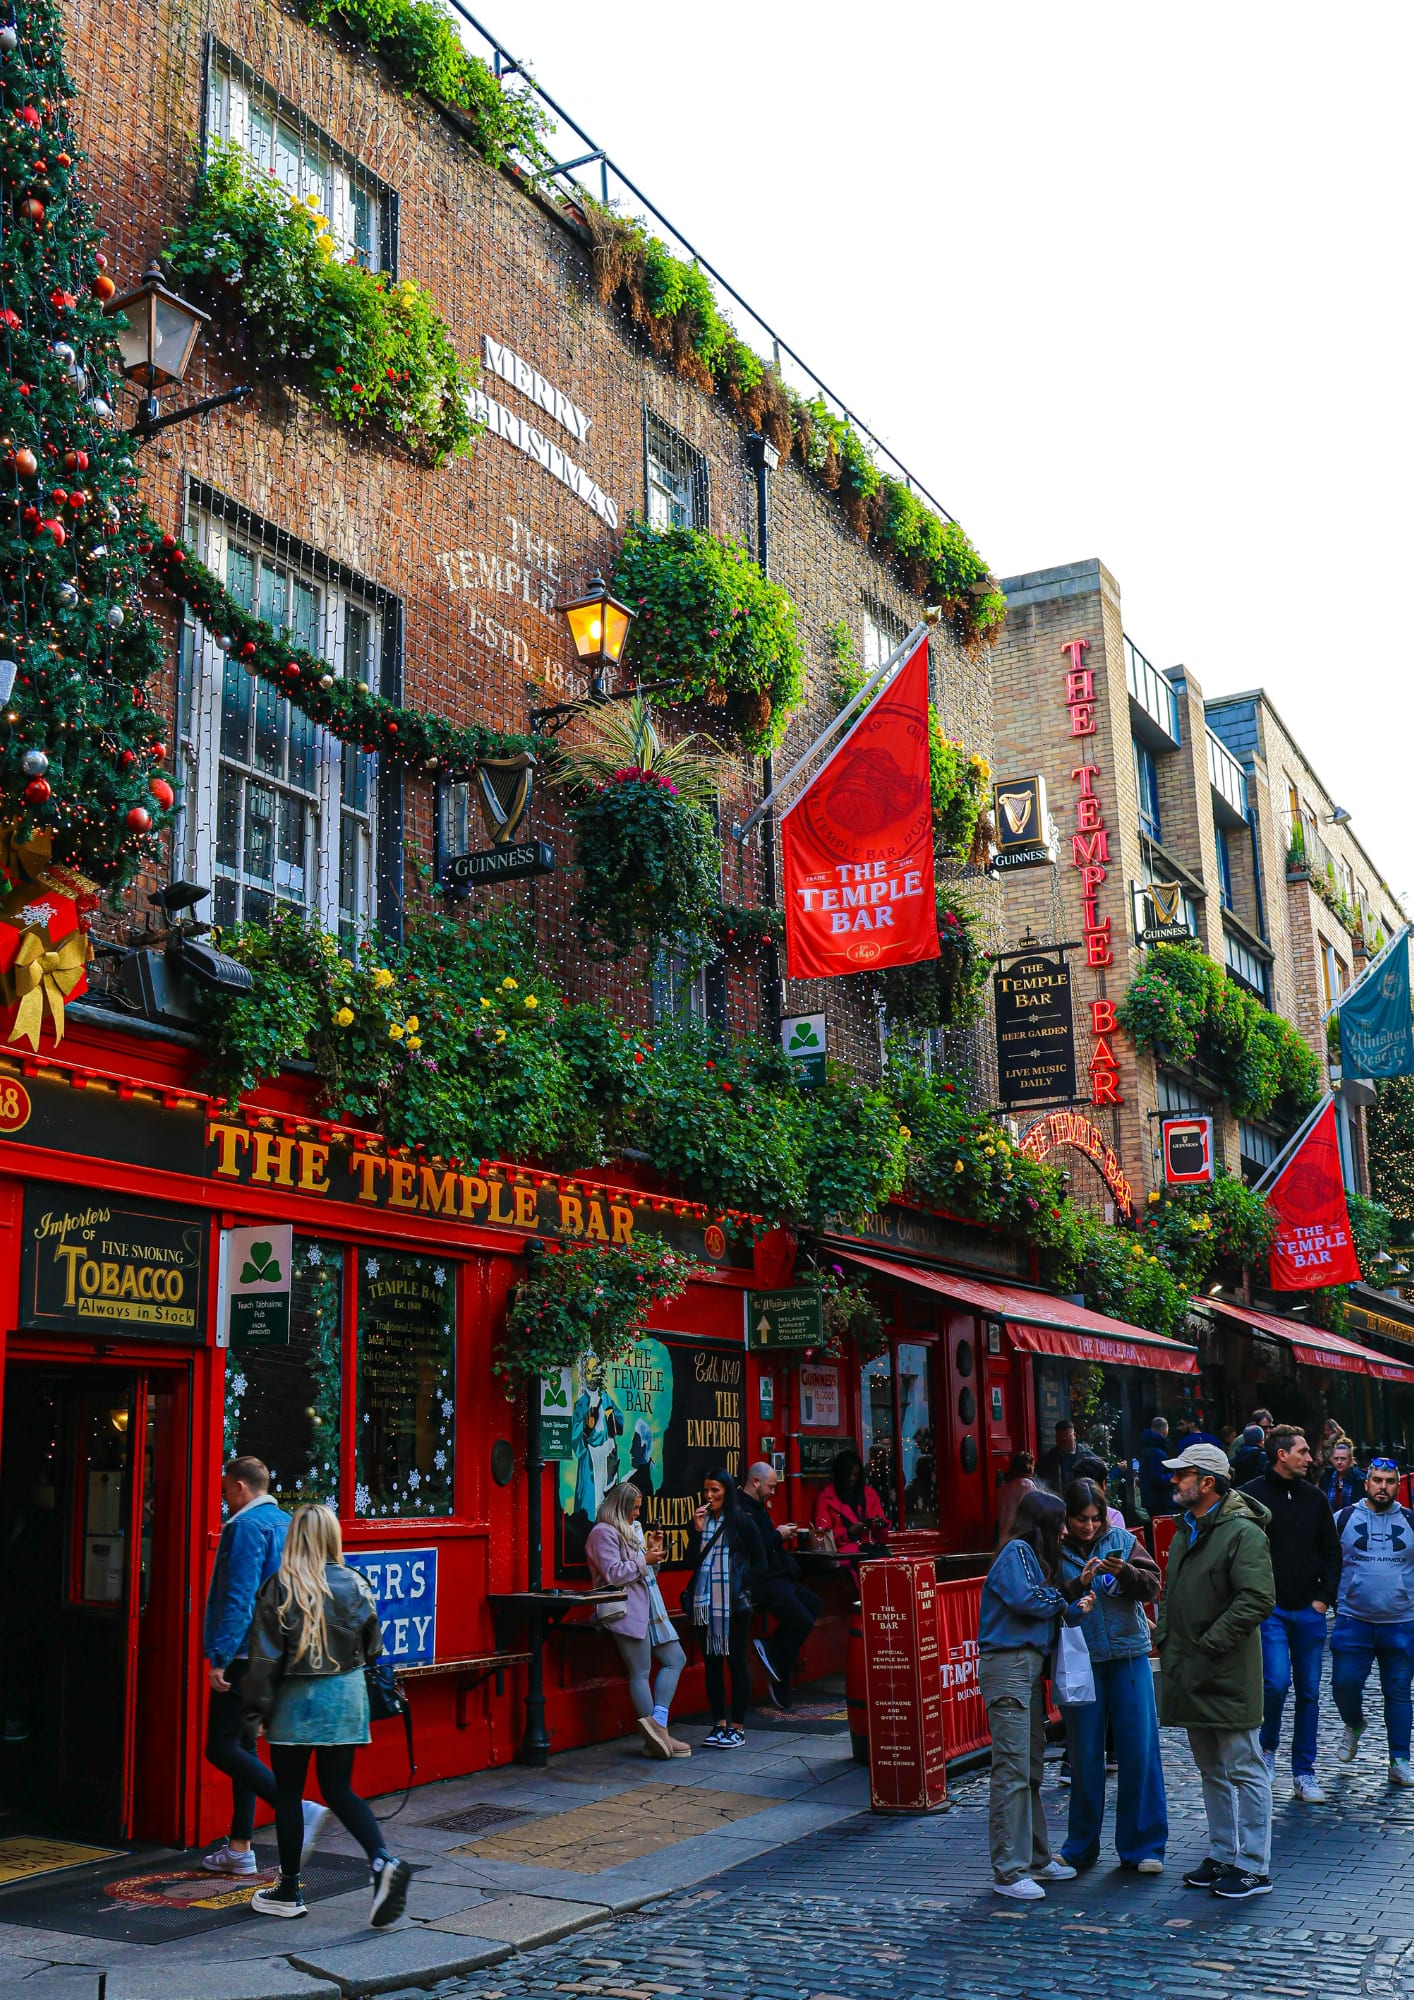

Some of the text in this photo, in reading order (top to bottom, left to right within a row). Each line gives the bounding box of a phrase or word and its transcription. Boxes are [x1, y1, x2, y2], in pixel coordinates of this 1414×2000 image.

[482, 334, 593, 445] MERRY
[505, 515, 561, 582] THE
[435, 549, 558, 620] TEMPLE
[455, 847, 535, 877] GUINNESS
[995, 848, 1048, 867] GUINNESS
[836, 861, 888, 883] THE
[1061, 639, 1123, 1106] THE TEMPLE BAR
[797, 871, 923, 912] TEMPLE
[830, 905, 895, 934] BAR
[1143, 926, 1188, 940] GUINNESS
[854, 949, 875, 959] 1840
[1020, 963, 1045, 974] THE
[998, 974, 1068, 993] TEMPLE
[1015, 993, 1053, 1008] BAR
[1002, 1026, 1068, 1041] BEER GARDEN
[1006, 1063, 1067, 1078] LIVE MUSIC
[1020, 1077, 1053, 1089] DAILY
[1047, 1111, 1103, 1160] TEMPLE
[1104, 1148, 1132, 1217] BAR
[209, 1122, 635, 1245] THE TEMPLE BAR
[34, 1206, 111, 1243] Importers
[1294, 1225, 1325, 1239] THE
[82, 1229, 97, 1241] OF
[1275, 1231, 1348, 1257] TEMPLE
[101, 1240, 184, 1264] FINE SMOKING
[1294, 1250, 1333, 1268] BAR
[53, 1243, 185, 1307] TOBACCO
[368, 1281, 445, 1307] TEMPLE BAR
[80, 1298, 193, 1323] Always in Stock
[254, 1310, 266, 1318] Pub
[777, 1315, 811, 1323] IRELAND'S
[778, 1321, 806, 1329] LARGEST
[778, 1328, 807, 1336] WHISKEY
[778, 1333, 817, 1341] COLLECTION
[1077, 1335, 1136, 1360] THE TEMPLE BAR
[611, 1367, 664, 1392] TEMPLE
[801, 1368, 836, 1387] GUINNESS
[625, 1390, 653, 1415] BAR
[714, 1391, 740, 1419] THE
[687, 1418, 741, 1448] EMPEROR
[726, 1449, 740, 1478] OF
[917, 1589, 935, 1600] TEMPLE
[922, 1600, 932, 1610] BAR
[870, 1612, 907, 1621] TEMPLE
[880, 1621, 898, 1630] BAR
